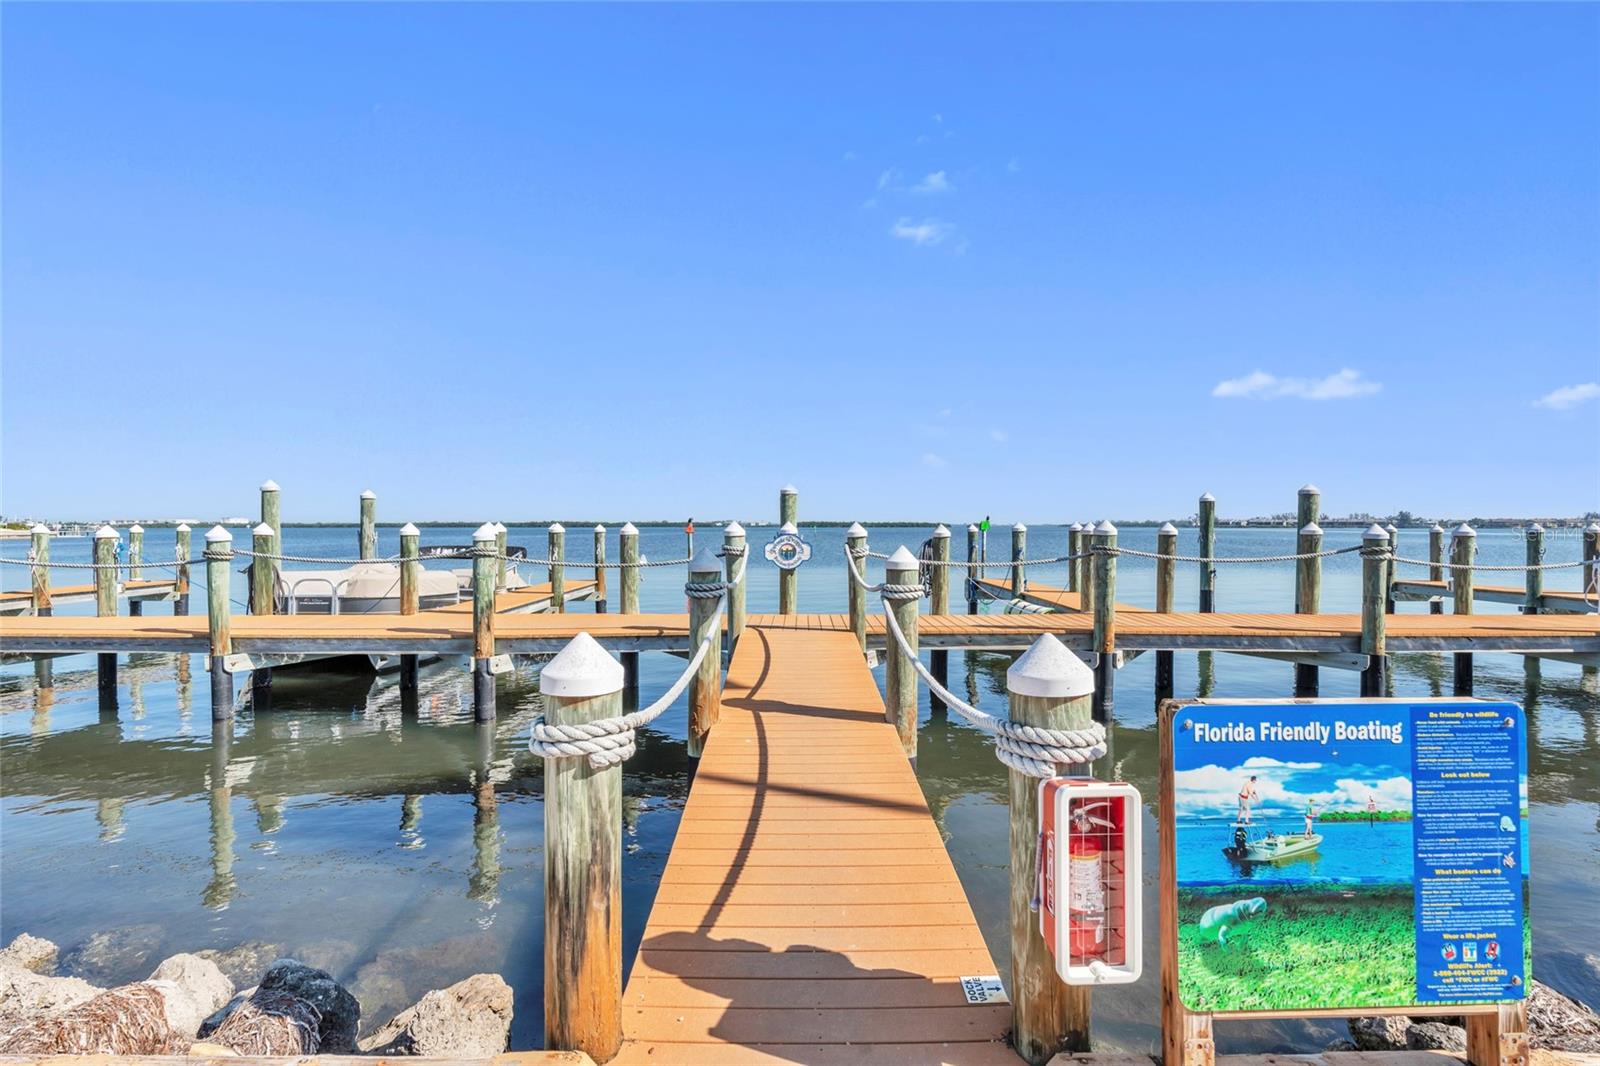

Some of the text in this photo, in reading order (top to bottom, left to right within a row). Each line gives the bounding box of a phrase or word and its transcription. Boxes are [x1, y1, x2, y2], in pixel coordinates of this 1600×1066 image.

[1439, 711, 1465, 719] friendly
[1194, 722, 1255, 742] Florida
[1260, 722, 1330, 745] Friendly
[1335, 720, 1403, 743] Boating
[964, 979, 979, 1001] DOCK
[972, 977, 988, 1002] VALVE
